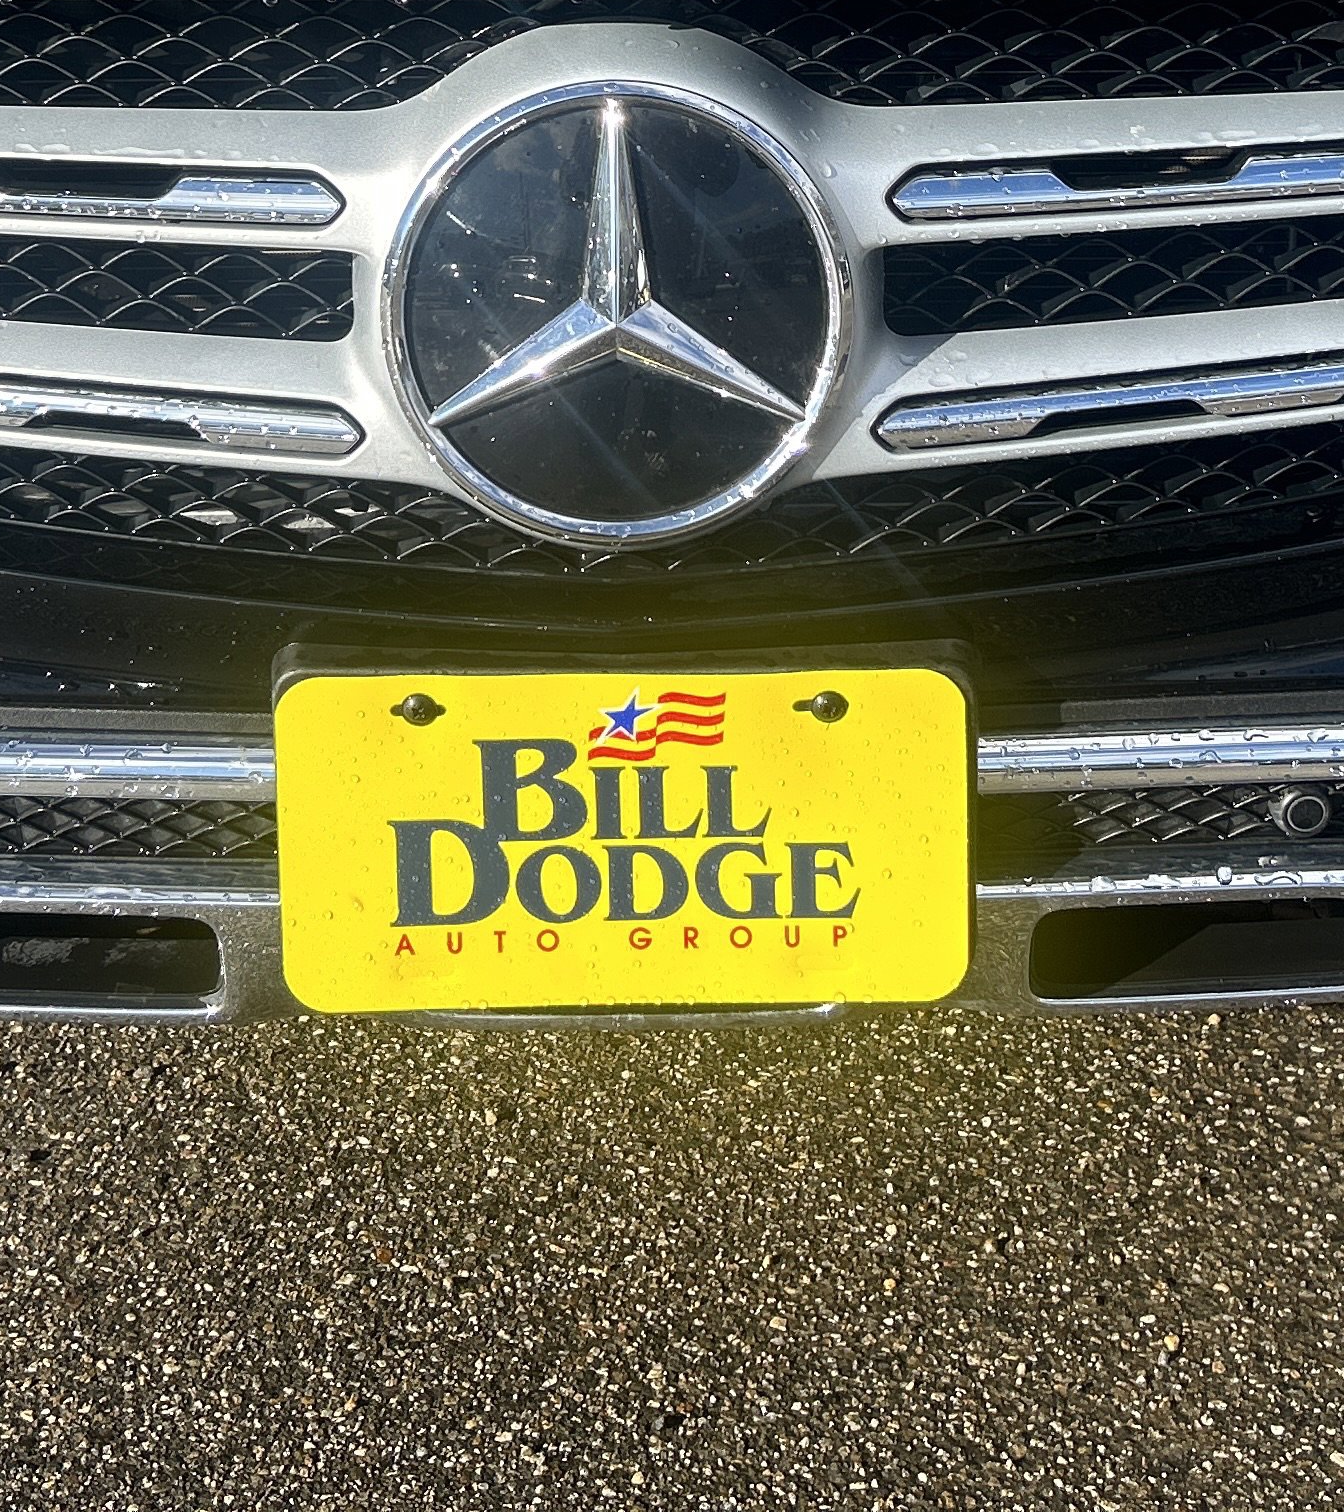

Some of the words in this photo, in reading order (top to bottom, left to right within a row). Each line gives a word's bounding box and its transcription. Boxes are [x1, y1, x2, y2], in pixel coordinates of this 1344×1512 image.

[472, 738, 771, 841] BILL
[387, 819, 861, 928] DODGE
[394, 929, 561, 956] AUTO
[628, 926, 848, 951] GROUP
